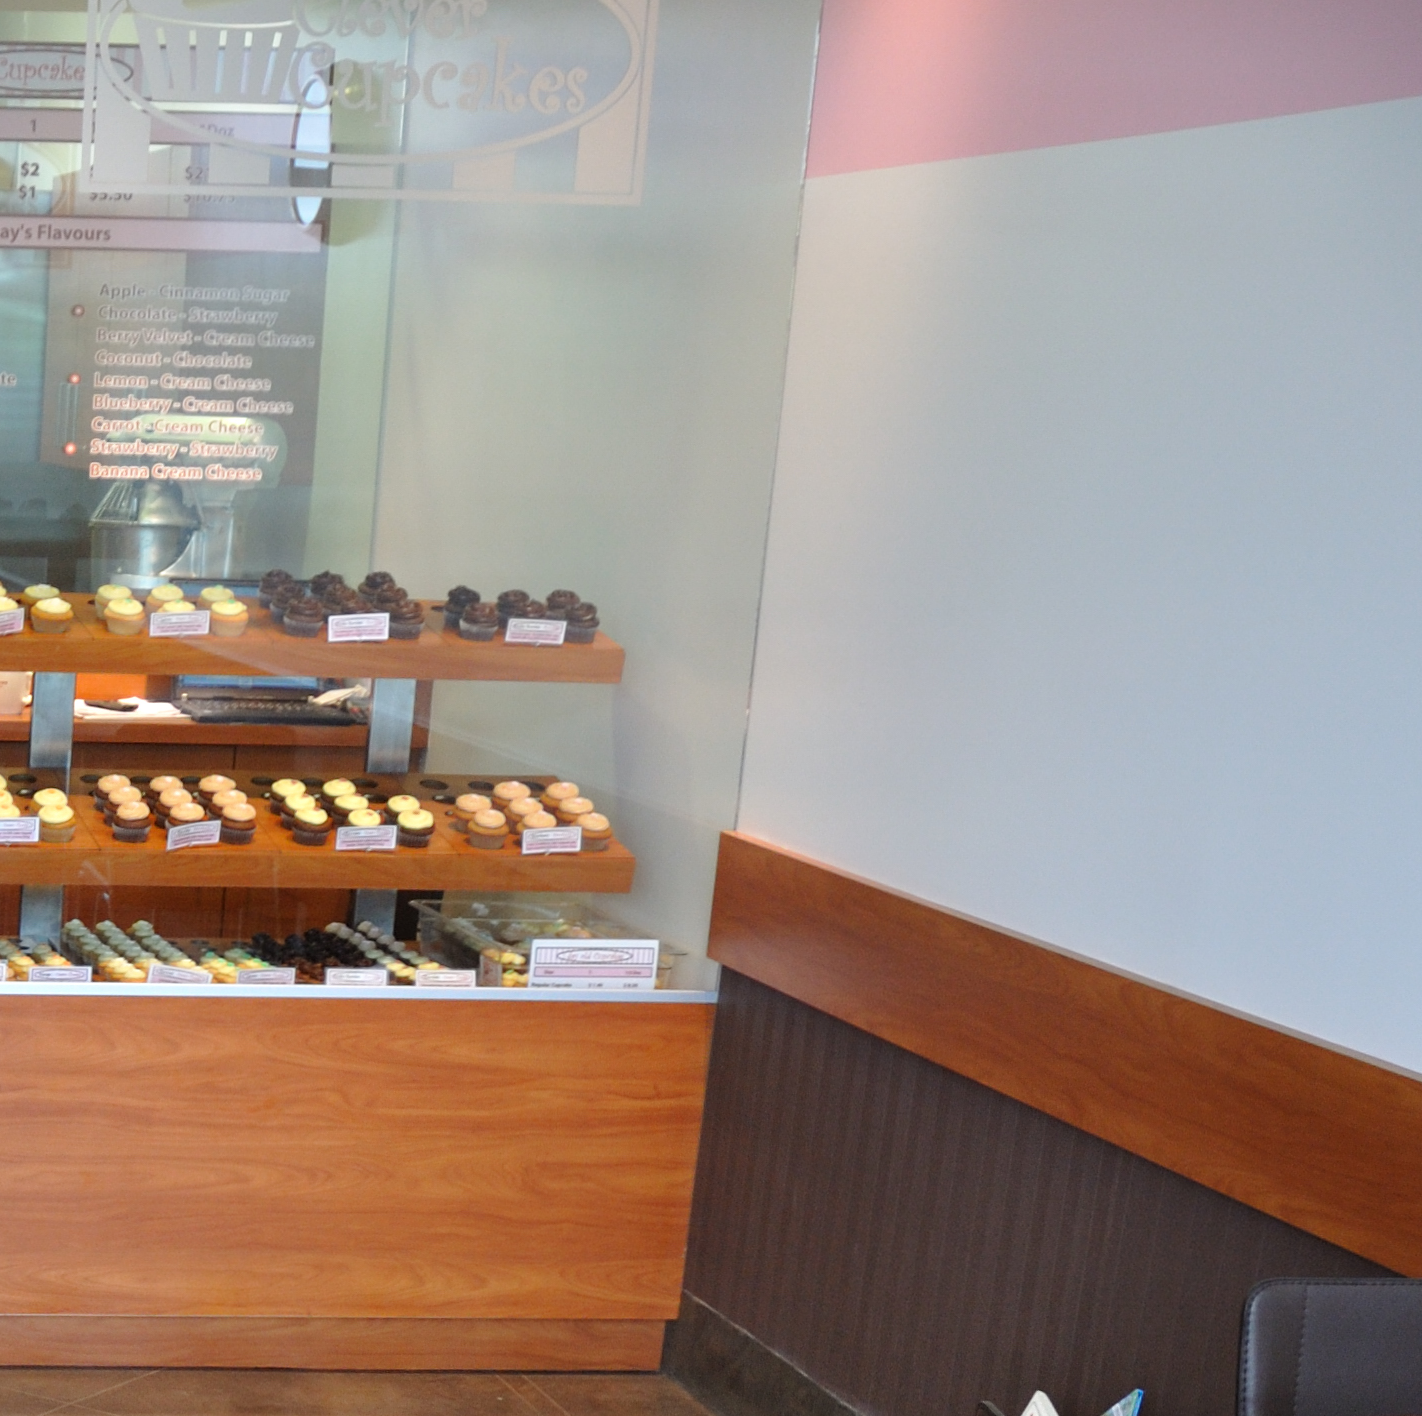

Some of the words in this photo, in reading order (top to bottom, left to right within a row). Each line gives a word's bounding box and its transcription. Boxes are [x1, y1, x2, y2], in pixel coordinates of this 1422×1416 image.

[288, 34, 589, 128] Cupcakes
[37, 223, 111, 241] Flavours
[99, 283, 146, 301] Apple
[159, 284, 240, 301] Cinnamon
[242, 285, 290, 305] Sugar
[98, 305, 177, 321] Chocolate
[188, 306, 279, 327] Strawberry
[96, 327, 140, 346] Berry
[142, 328, 193, 345] Velvet
[203, 329, 256, 347] Cream
[257, 330, 316, 348] Cheese
[94, 349, 162, 366] Coconut
[172, 351, 253, 368] Chocolate
[93, 372, 149, 390] Lemon
[159, 373, 212, 391] Cream
[213, 374, 272, 392] Cheese
[92, 394, 173, 414] Blueberry
[182, 396, 234, 412] Cream
[236, 397, 294, 415] Cheese
[91, 416, 141, 432] Carrot
[152, 418, 203, 434] Cream
[207, 419, 265, 435] Cheese
[89, 438, 180, 459] Strawberry
[189, 440, 280, 461] Strawberry
[89, 462, 150, 479] Banana
[151, 463, 203, 480] Cream
[205, 464, 263, 481] Cheese
